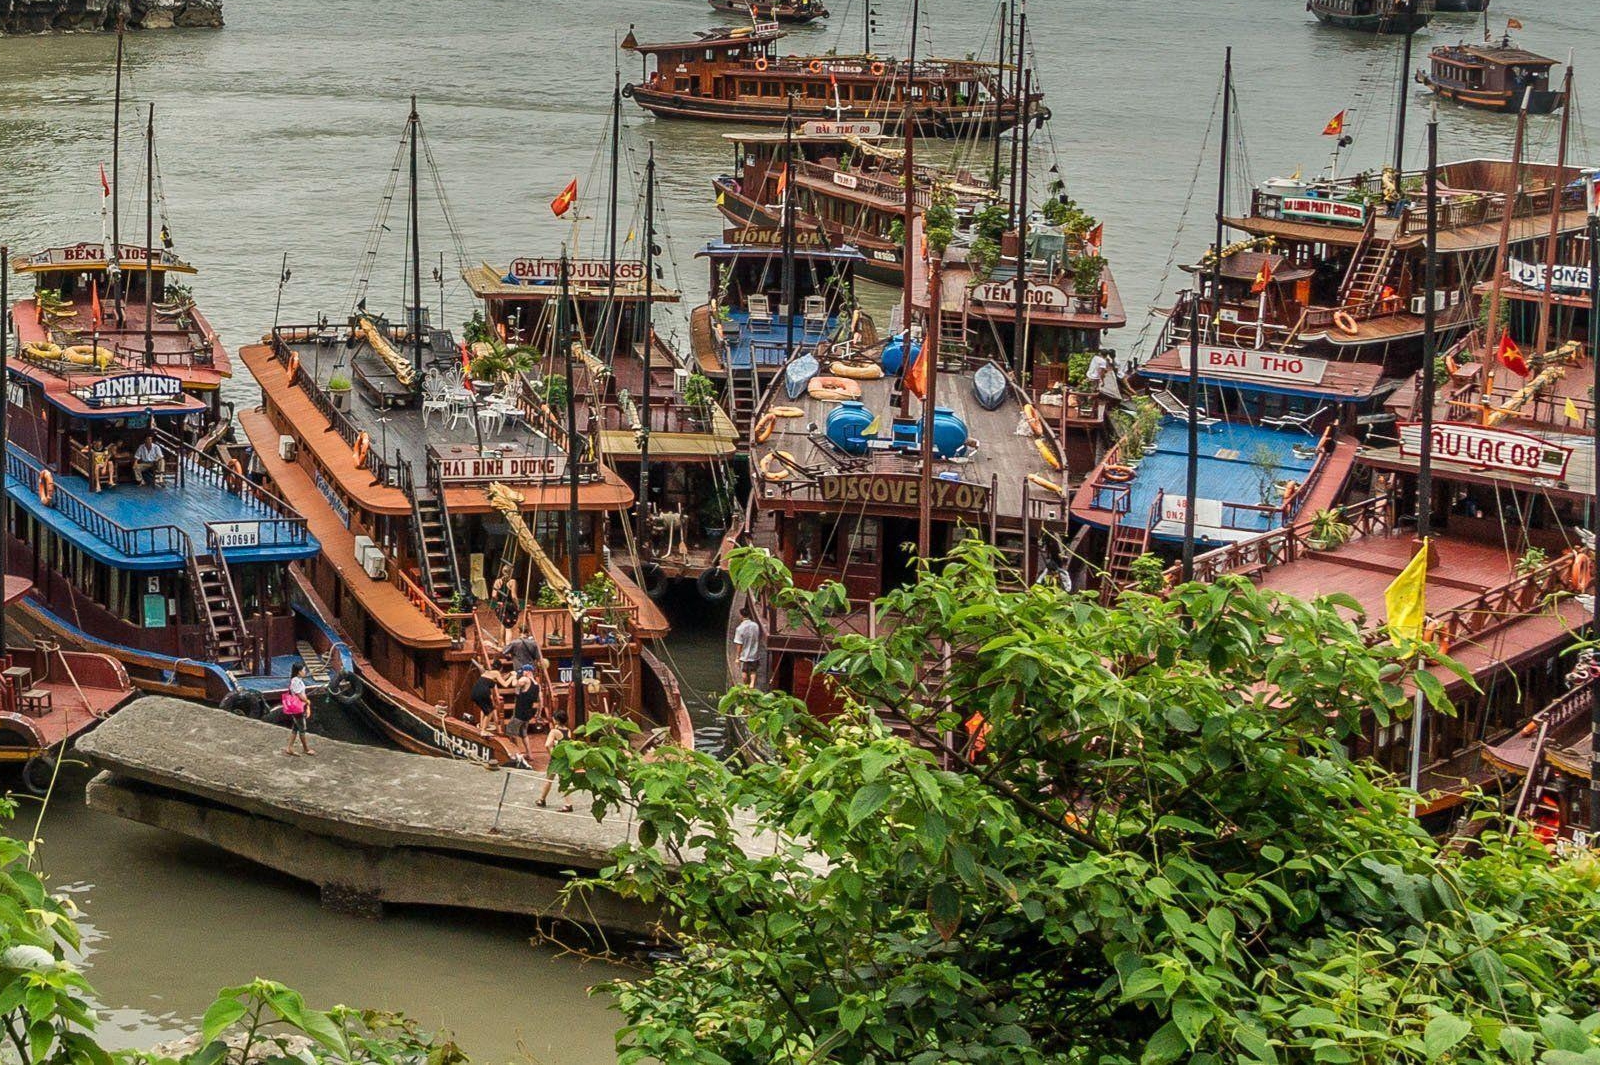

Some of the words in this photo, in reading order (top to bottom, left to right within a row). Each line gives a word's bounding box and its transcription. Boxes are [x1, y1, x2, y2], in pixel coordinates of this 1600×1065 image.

[138, 376, 181, 395] MINH
[1511, 444, 1541, 469] 08
[150, 576, 158, 592] 5
